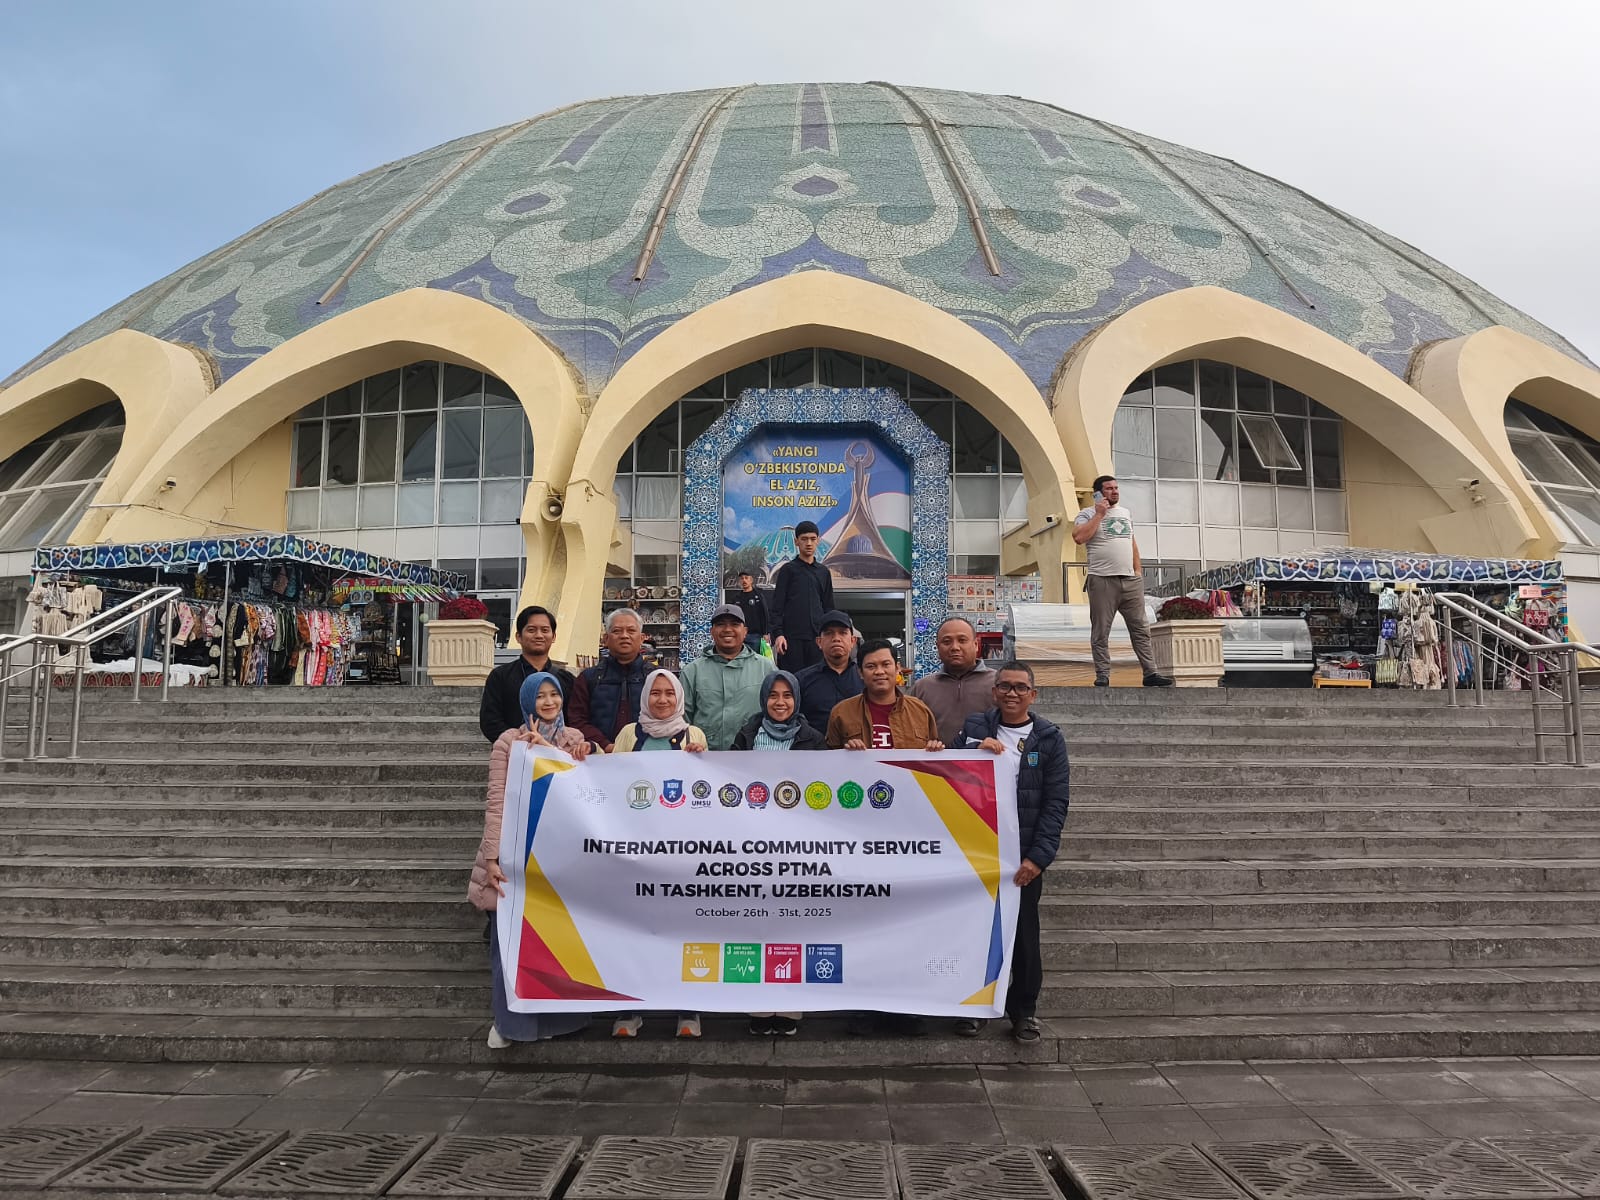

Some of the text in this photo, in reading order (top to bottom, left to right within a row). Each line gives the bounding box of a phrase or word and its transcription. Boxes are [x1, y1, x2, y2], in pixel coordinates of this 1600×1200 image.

[770, 480, 821, 492] EL AZIZ,
[753, 496, 794, 507] INSON
[583, 838, 941, 855] INTERNATIONAL COMMUNITY SERVICE
[695, 862, 832, 876] ACROSS PTMA
[635, 883, 891, 899] IN TASHKENT, UZBEKISTAN
[695, 908, 740, 917] October
[743, 908, 769, 917] 26th
[778, 908, 801, 918] 31st,
[804, 908, 832, 917] 2025
[685, 945, 690, 954] 2
[726, 945, 732, 955] 3
[767, 946, 773, 956] 8
[807, 946, 815, 956] 17
